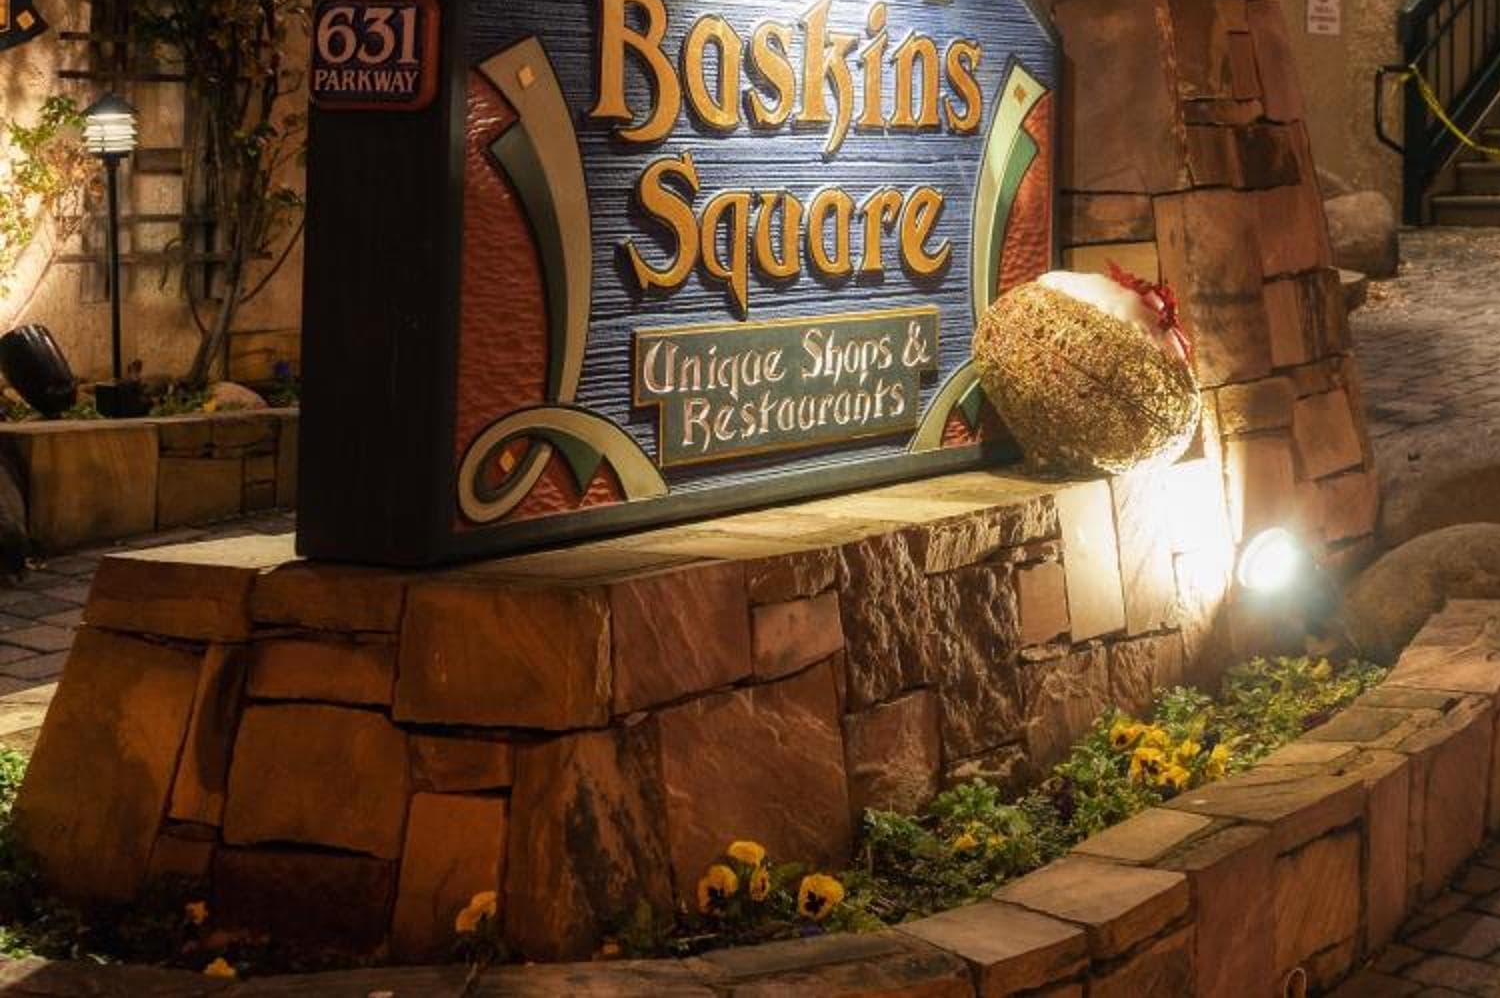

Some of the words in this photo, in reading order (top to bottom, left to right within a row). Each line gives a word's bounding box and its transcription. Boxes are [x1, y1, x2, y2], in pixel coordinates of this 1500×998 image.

[317, 6, 419, 65] 631
[314, 68, 419, 93] PARKWAY
[622, 151, 952, 322] Square
[643, 339, 786, 400] Unique
[801, 328, 894, 387] Shops
[902, 320, 932, 368] &
[681, 378, 906, 452] Restaurants
